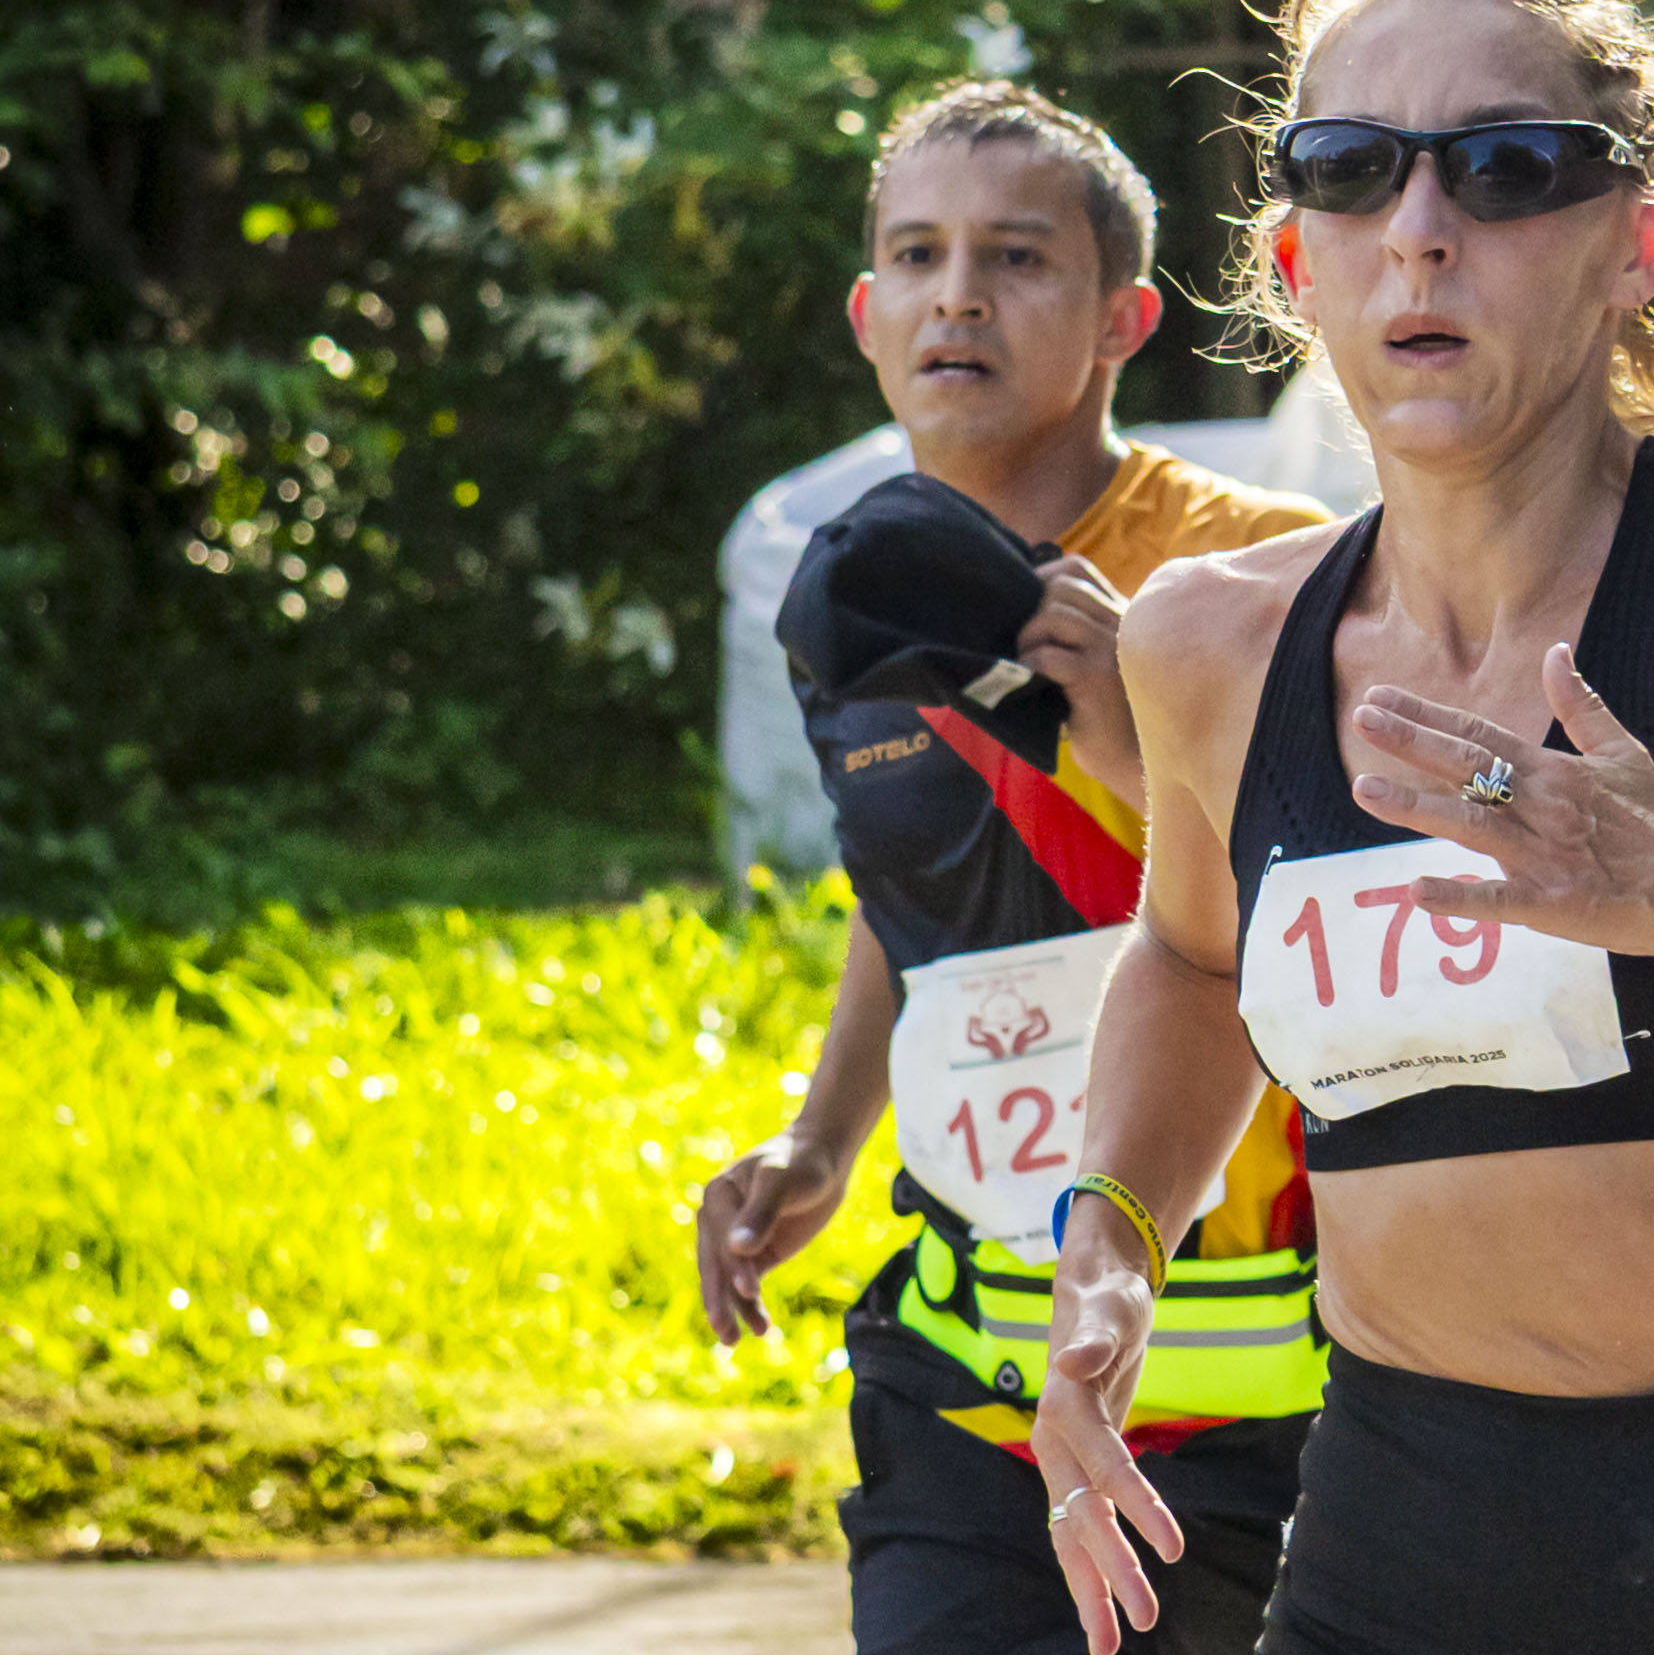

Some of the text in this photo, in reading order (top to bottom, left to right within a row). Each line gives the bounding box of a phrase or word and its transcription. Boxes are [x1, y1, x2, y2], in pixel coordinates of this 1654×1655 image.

[1282, 874, 1502, 1008] 179
[1389, 1055, 1467, 1071] SOLIDARIA
[1469, 1049, 1507, 1065] 2025
[948, 1086, 1087, 1183] 12
[1086, 1175, 1147, 1220] Central
